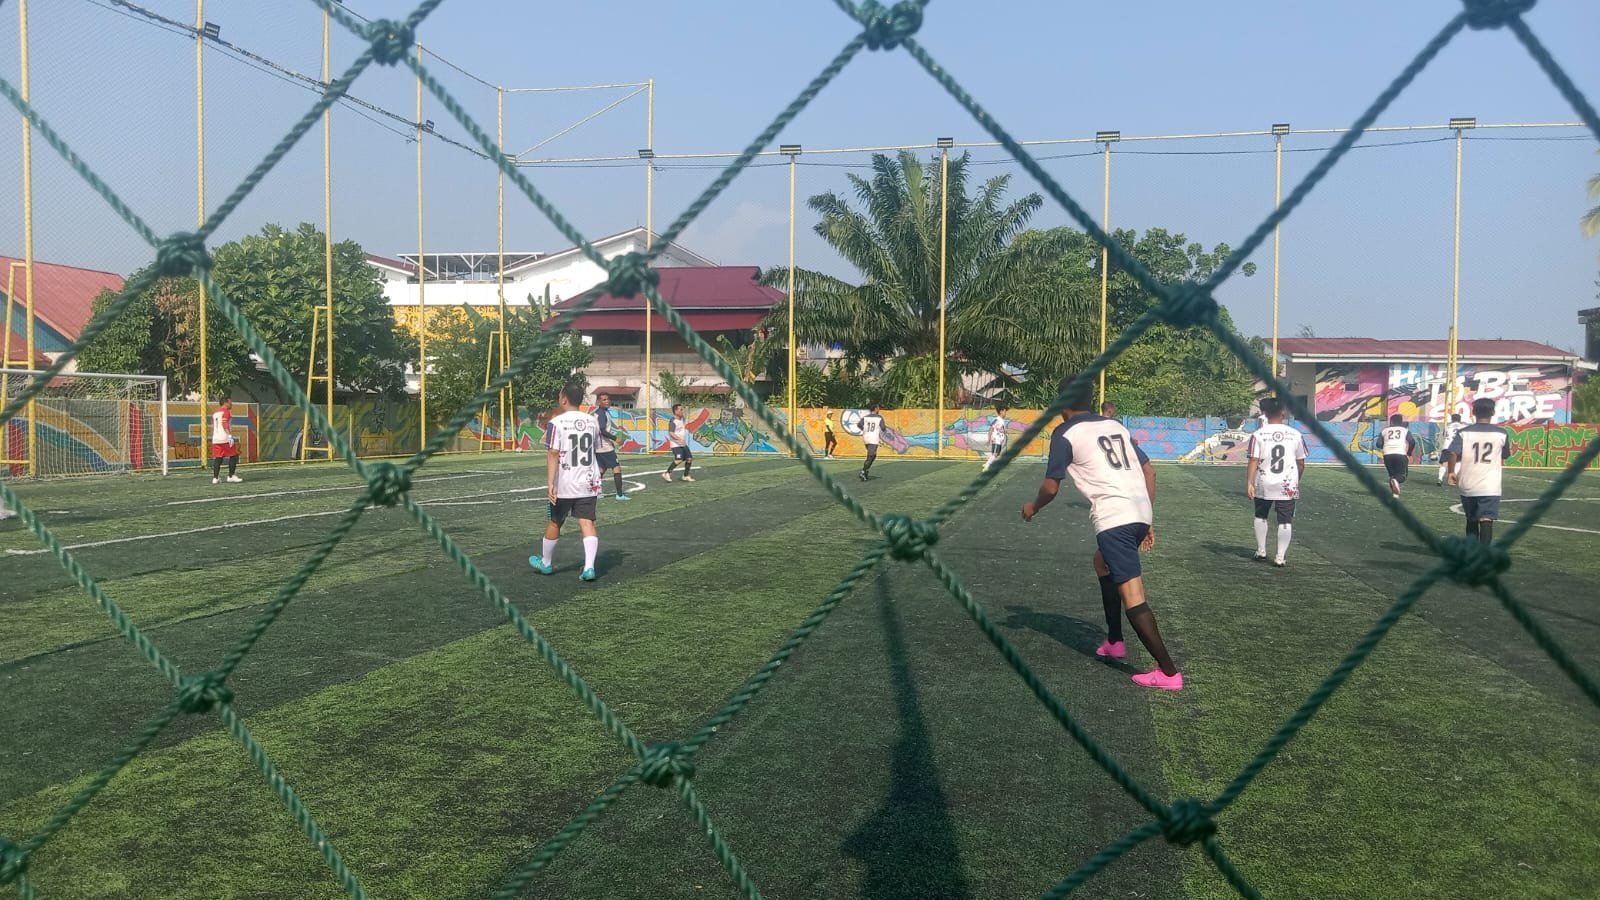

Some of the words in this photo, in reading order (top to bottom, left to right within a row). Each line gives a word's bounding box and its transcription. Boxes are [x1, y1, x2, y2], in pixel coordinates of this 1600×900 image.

[1472, 367, 1546, 400] BE
[1429, 393, 1561, 423] SQARE
[867, 422, 878, 432] 18
[1388, 429, 1401, 440] 23
[568, 433, 592, 467] 19
[1097, 433, 1131, 471] 87
[1270, 444, 1285, 474] 8
[1472, 442, 1493, 464] 12
